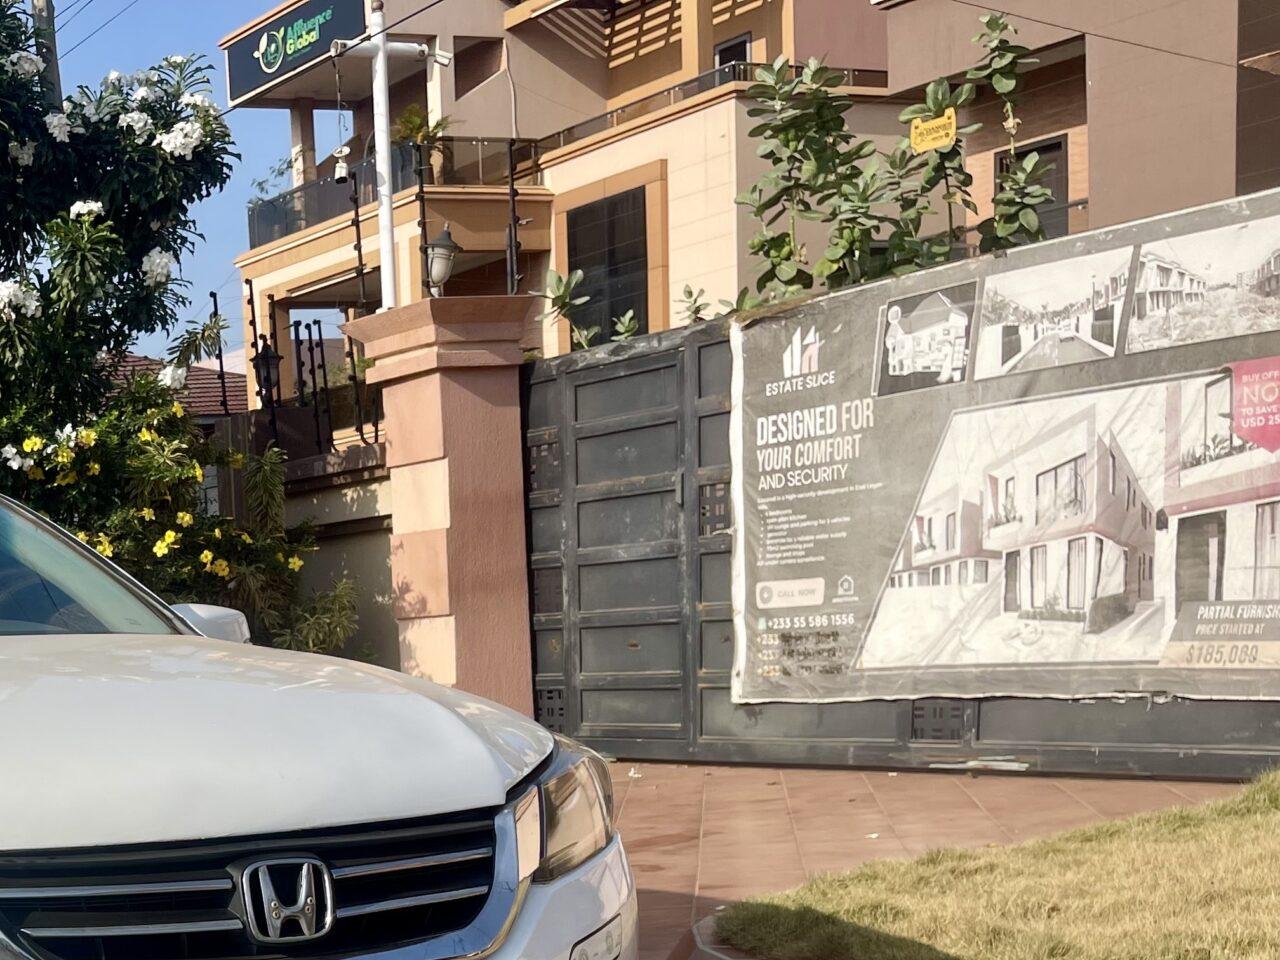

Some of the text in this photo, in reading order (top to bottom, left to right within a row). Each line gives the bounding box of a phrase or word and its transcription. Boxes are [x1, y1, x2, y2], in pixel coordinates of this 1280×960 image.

[287, 10, 332, 39] Affluence
[286, 20, 319, 54] Global
[766, 370, 835, 396] ESTATE SLICE
[1242, 374, 1260, 383] BUY
[1241, 404, 1278, 416] TO SAVE
[756, 398, 874, 446] DESIGNED FOR
[1241, 416, 1265, 428] USD
[756, 434, 862, 472] YOUR COMFORT
[758, 464, 848, 491] AND SECURITY
[777, 588, 816, 598] CALL NOW
[1197, 604, 1280, 619] PARTIAL FURNISH
[768, 613, 855, 629] +233 55 586 1556
[1195, 623, 1265, 635] PRICE STARTED AT
